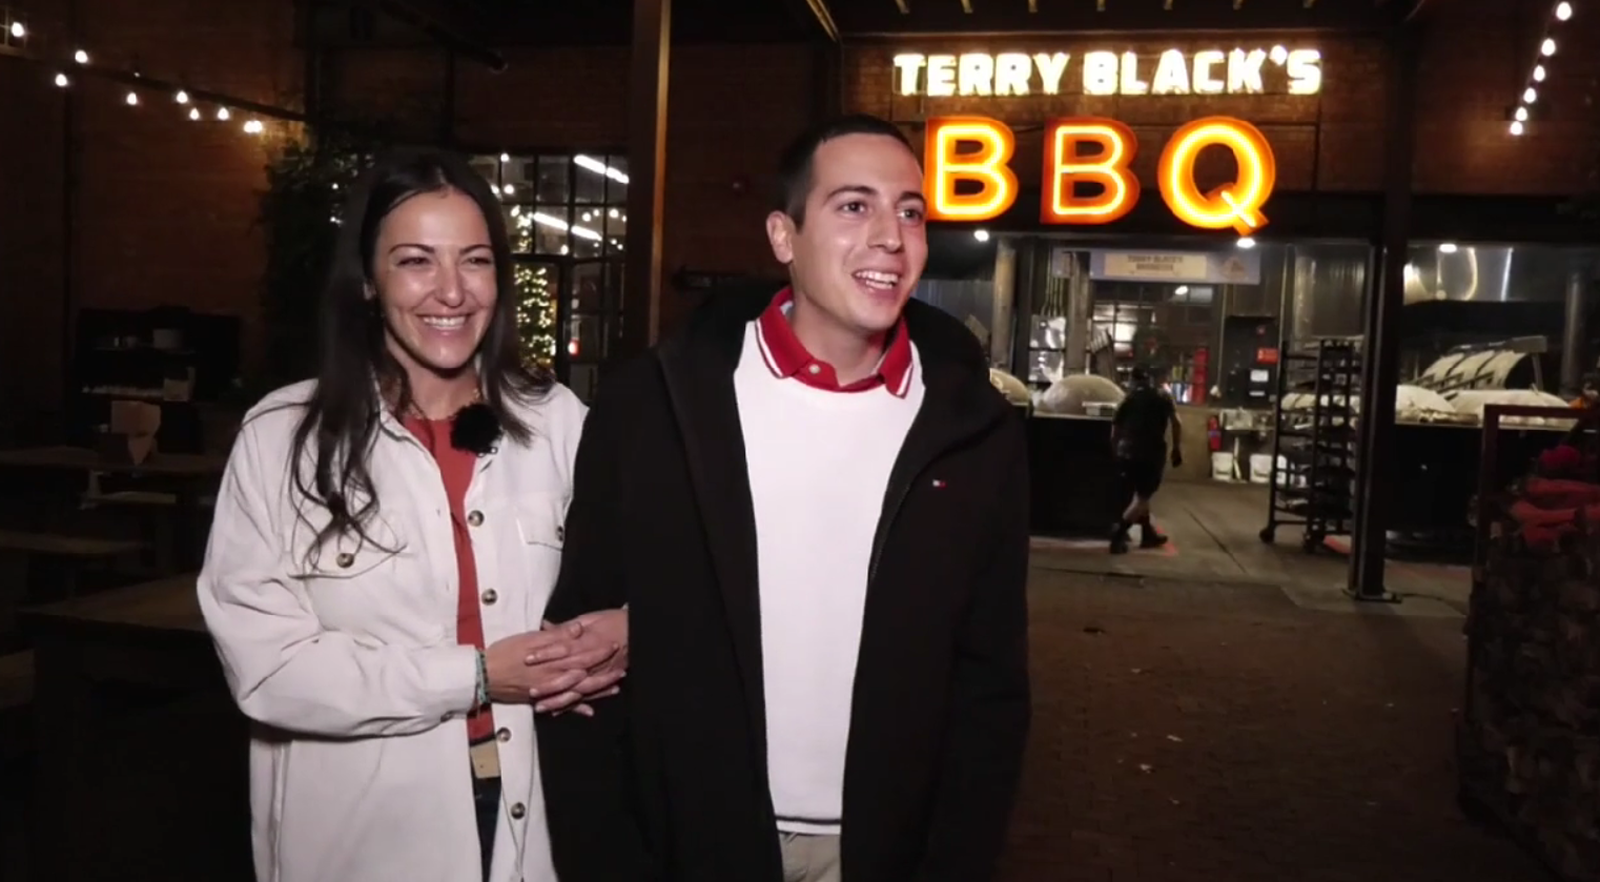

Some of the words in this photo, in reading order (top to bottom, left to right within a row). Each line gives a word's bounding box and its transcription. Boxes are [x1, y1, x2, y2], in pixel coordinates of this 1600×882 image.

[893, 53, 1070, 96] TERRY
[1082, 45, 1322, 96] BLACK'S
[925, 116, 1277, 235] BBQ
